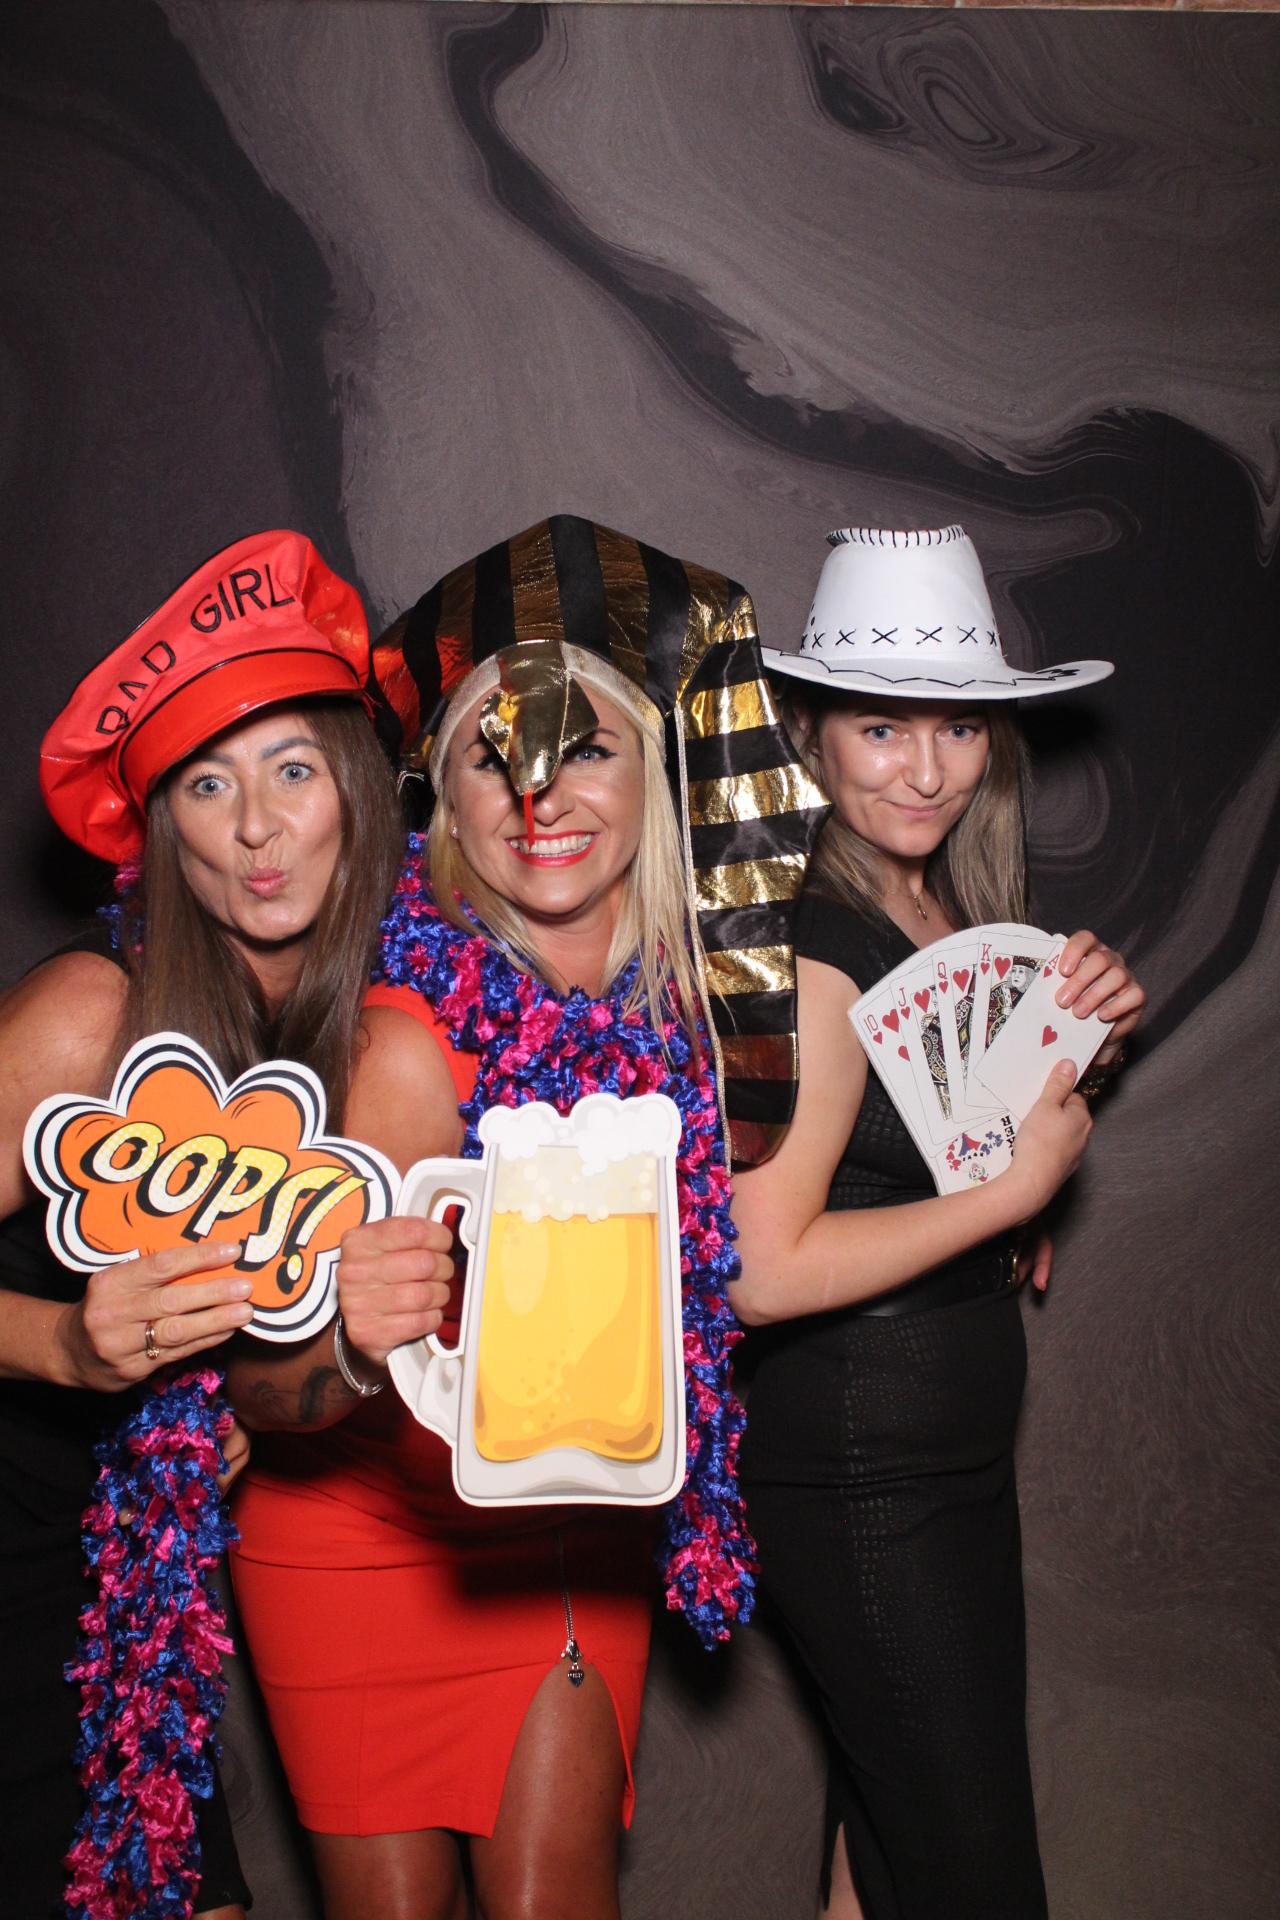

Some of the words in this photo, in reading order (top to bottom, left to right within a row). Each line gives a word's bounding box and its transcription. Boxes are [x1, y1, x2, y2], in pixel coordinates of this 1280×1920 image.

[190, 563, 295, 633] GIRL
[981, 943, 992, 962] K
[1048, 954, 1060, 969] A
[937, 961, 947, 979] Q
[898, 987, 907, 1007] J
[863, 1014, 879, 1034] 10
[81, 1121, 374, 1294] OOPS!
